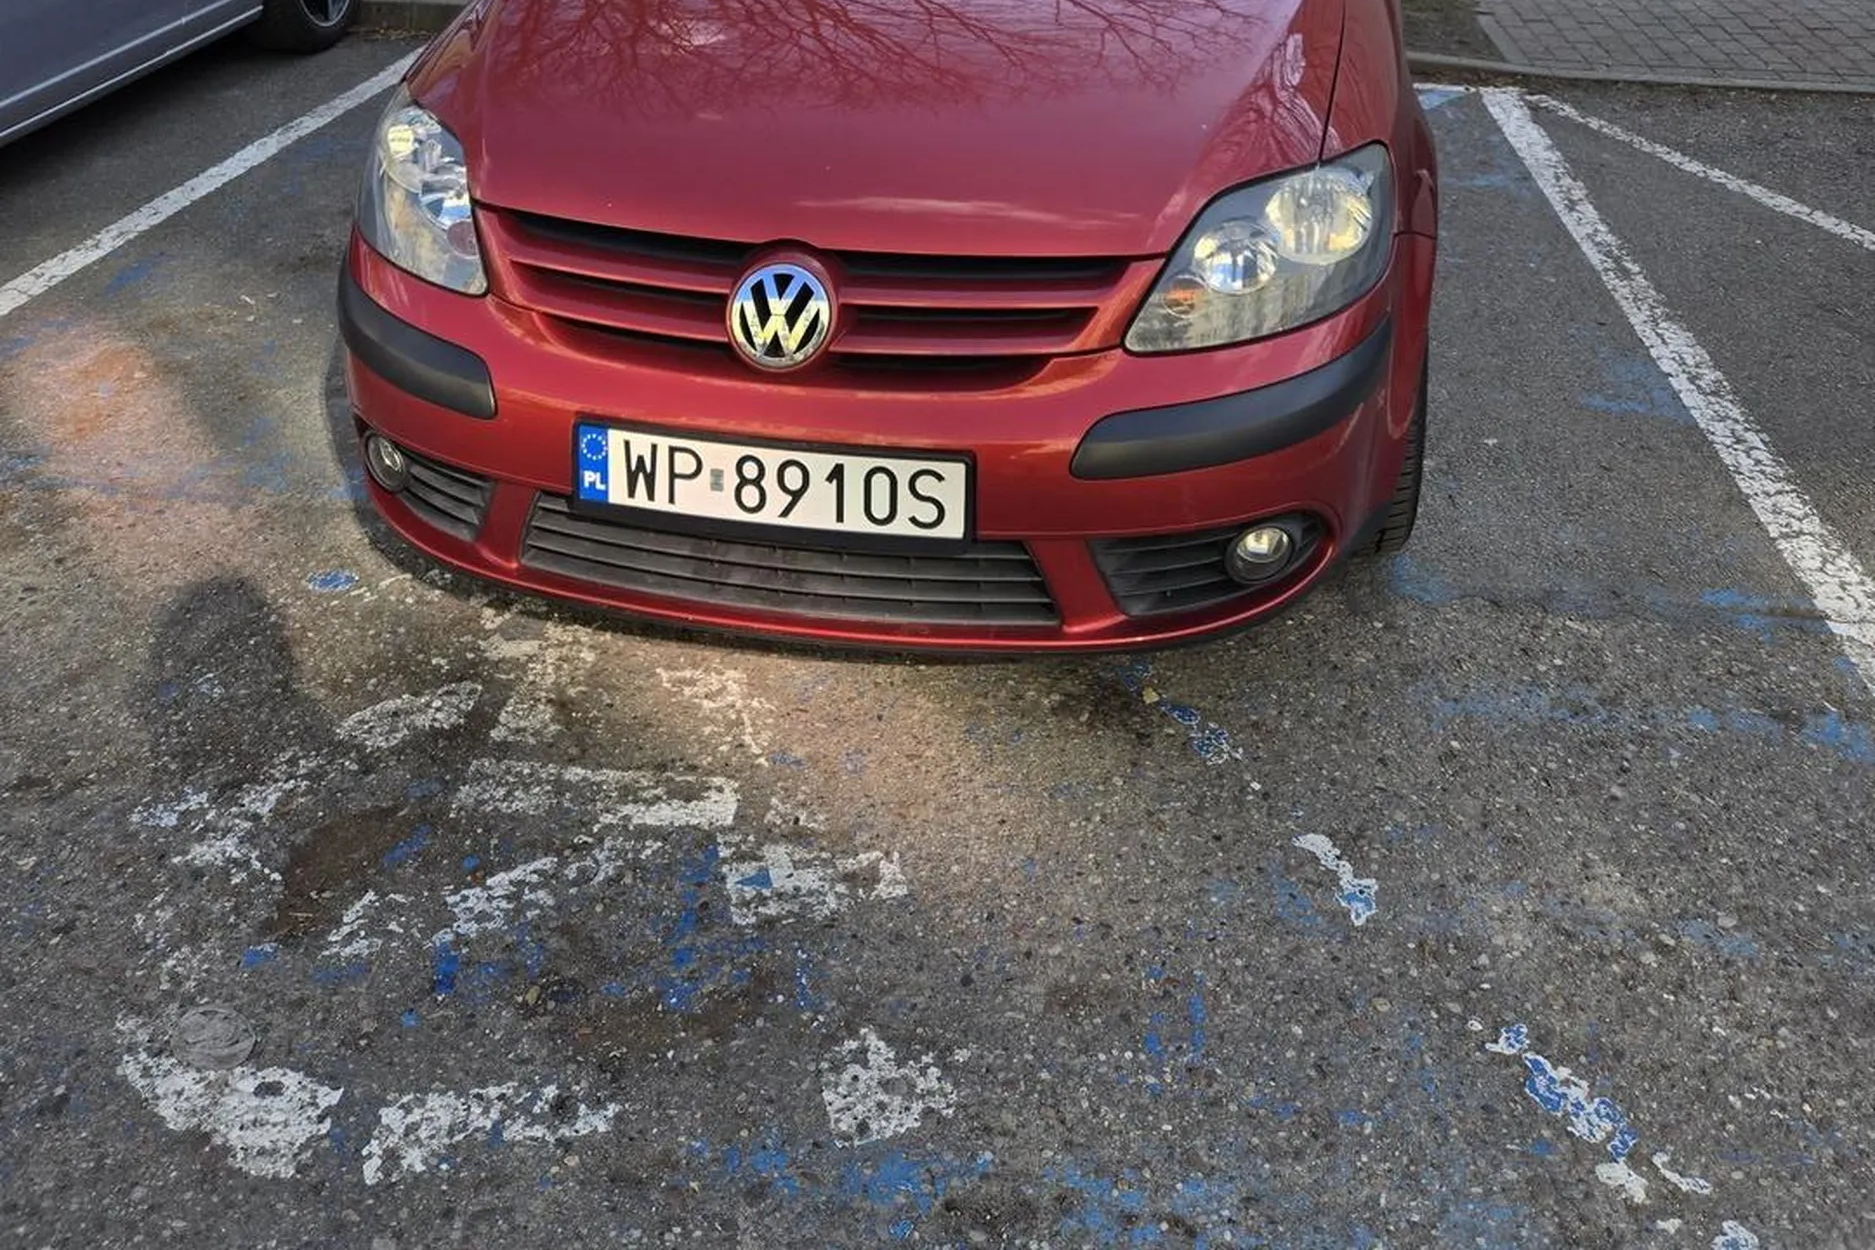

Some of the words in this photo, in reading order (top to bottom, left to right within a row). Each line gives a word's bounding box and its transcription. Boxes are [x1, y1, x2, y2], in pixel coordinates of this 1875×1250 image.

[584, 469, 605, 490] PL
[624, 438, 703, 504] WP
[734, 454, 946, 529] 8910S
